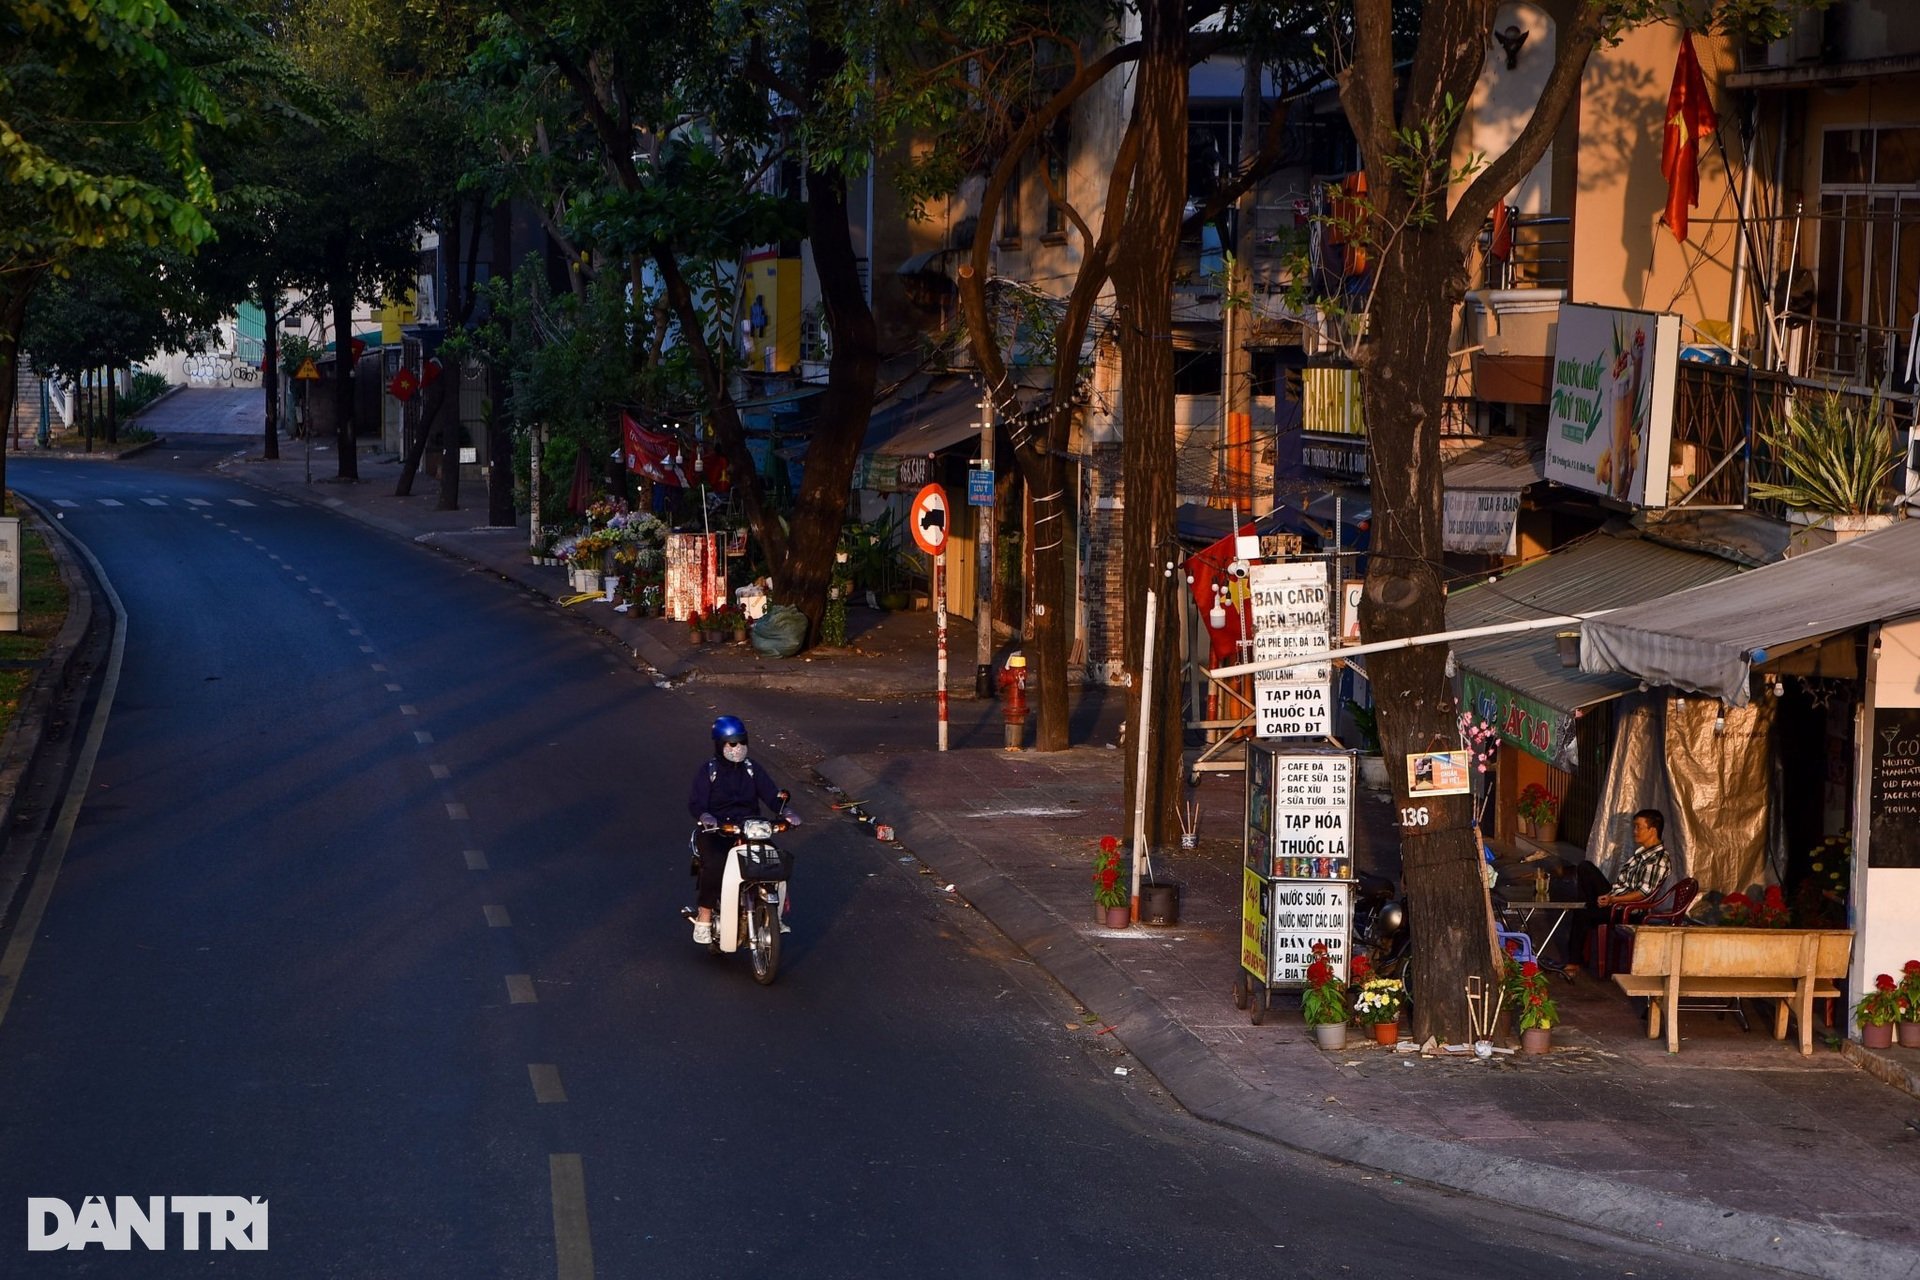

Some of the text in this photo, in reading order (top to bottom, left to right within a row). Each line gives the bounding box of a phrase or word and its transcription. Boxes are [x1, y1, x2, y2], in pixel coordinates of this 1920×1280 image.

[1478, 497, 1493, 512] MUA
[1495, 497, 1501, 512] &
[1287, 588, 1324, 604] CARD
[1266, 687, 1321, 703] TẠP HÓA
[1262, 703, 1326, 718] THUỐC LÁ
[1267, 722, 1321, 734] CARD ĐT
[1287, 761, 1346, 771] CAFE ĐÁ 12k
[1287, 774, 1309, 782] CAFE
[1333, 774, 1346, 782] 15k
[1882, 779, 1898, 789] OLD
[1333, 786, 1346, 794] 15k
[1333, 797, 1346, 805] 15k
[1884, 805, 1917, 814] TEQUILA
[1285, 811, 1342, 832] TẠP HÓA
[1401, 807, 1429, 827] 136
[1280, 834, 1345, 854] THUỐC LÁ
[1280, 889, 1303, 906] NƯỚC
[1305, 888, 1326, 906] SUỐI
[1278, 910, 1344, 931] NƯỚC NGỌT CÁC LOẠI
[1280, 934, 1305, 948] BÁN
[1285, 953, 1299, 963] BIA
[1284, 968, 1298, 979] BIA
